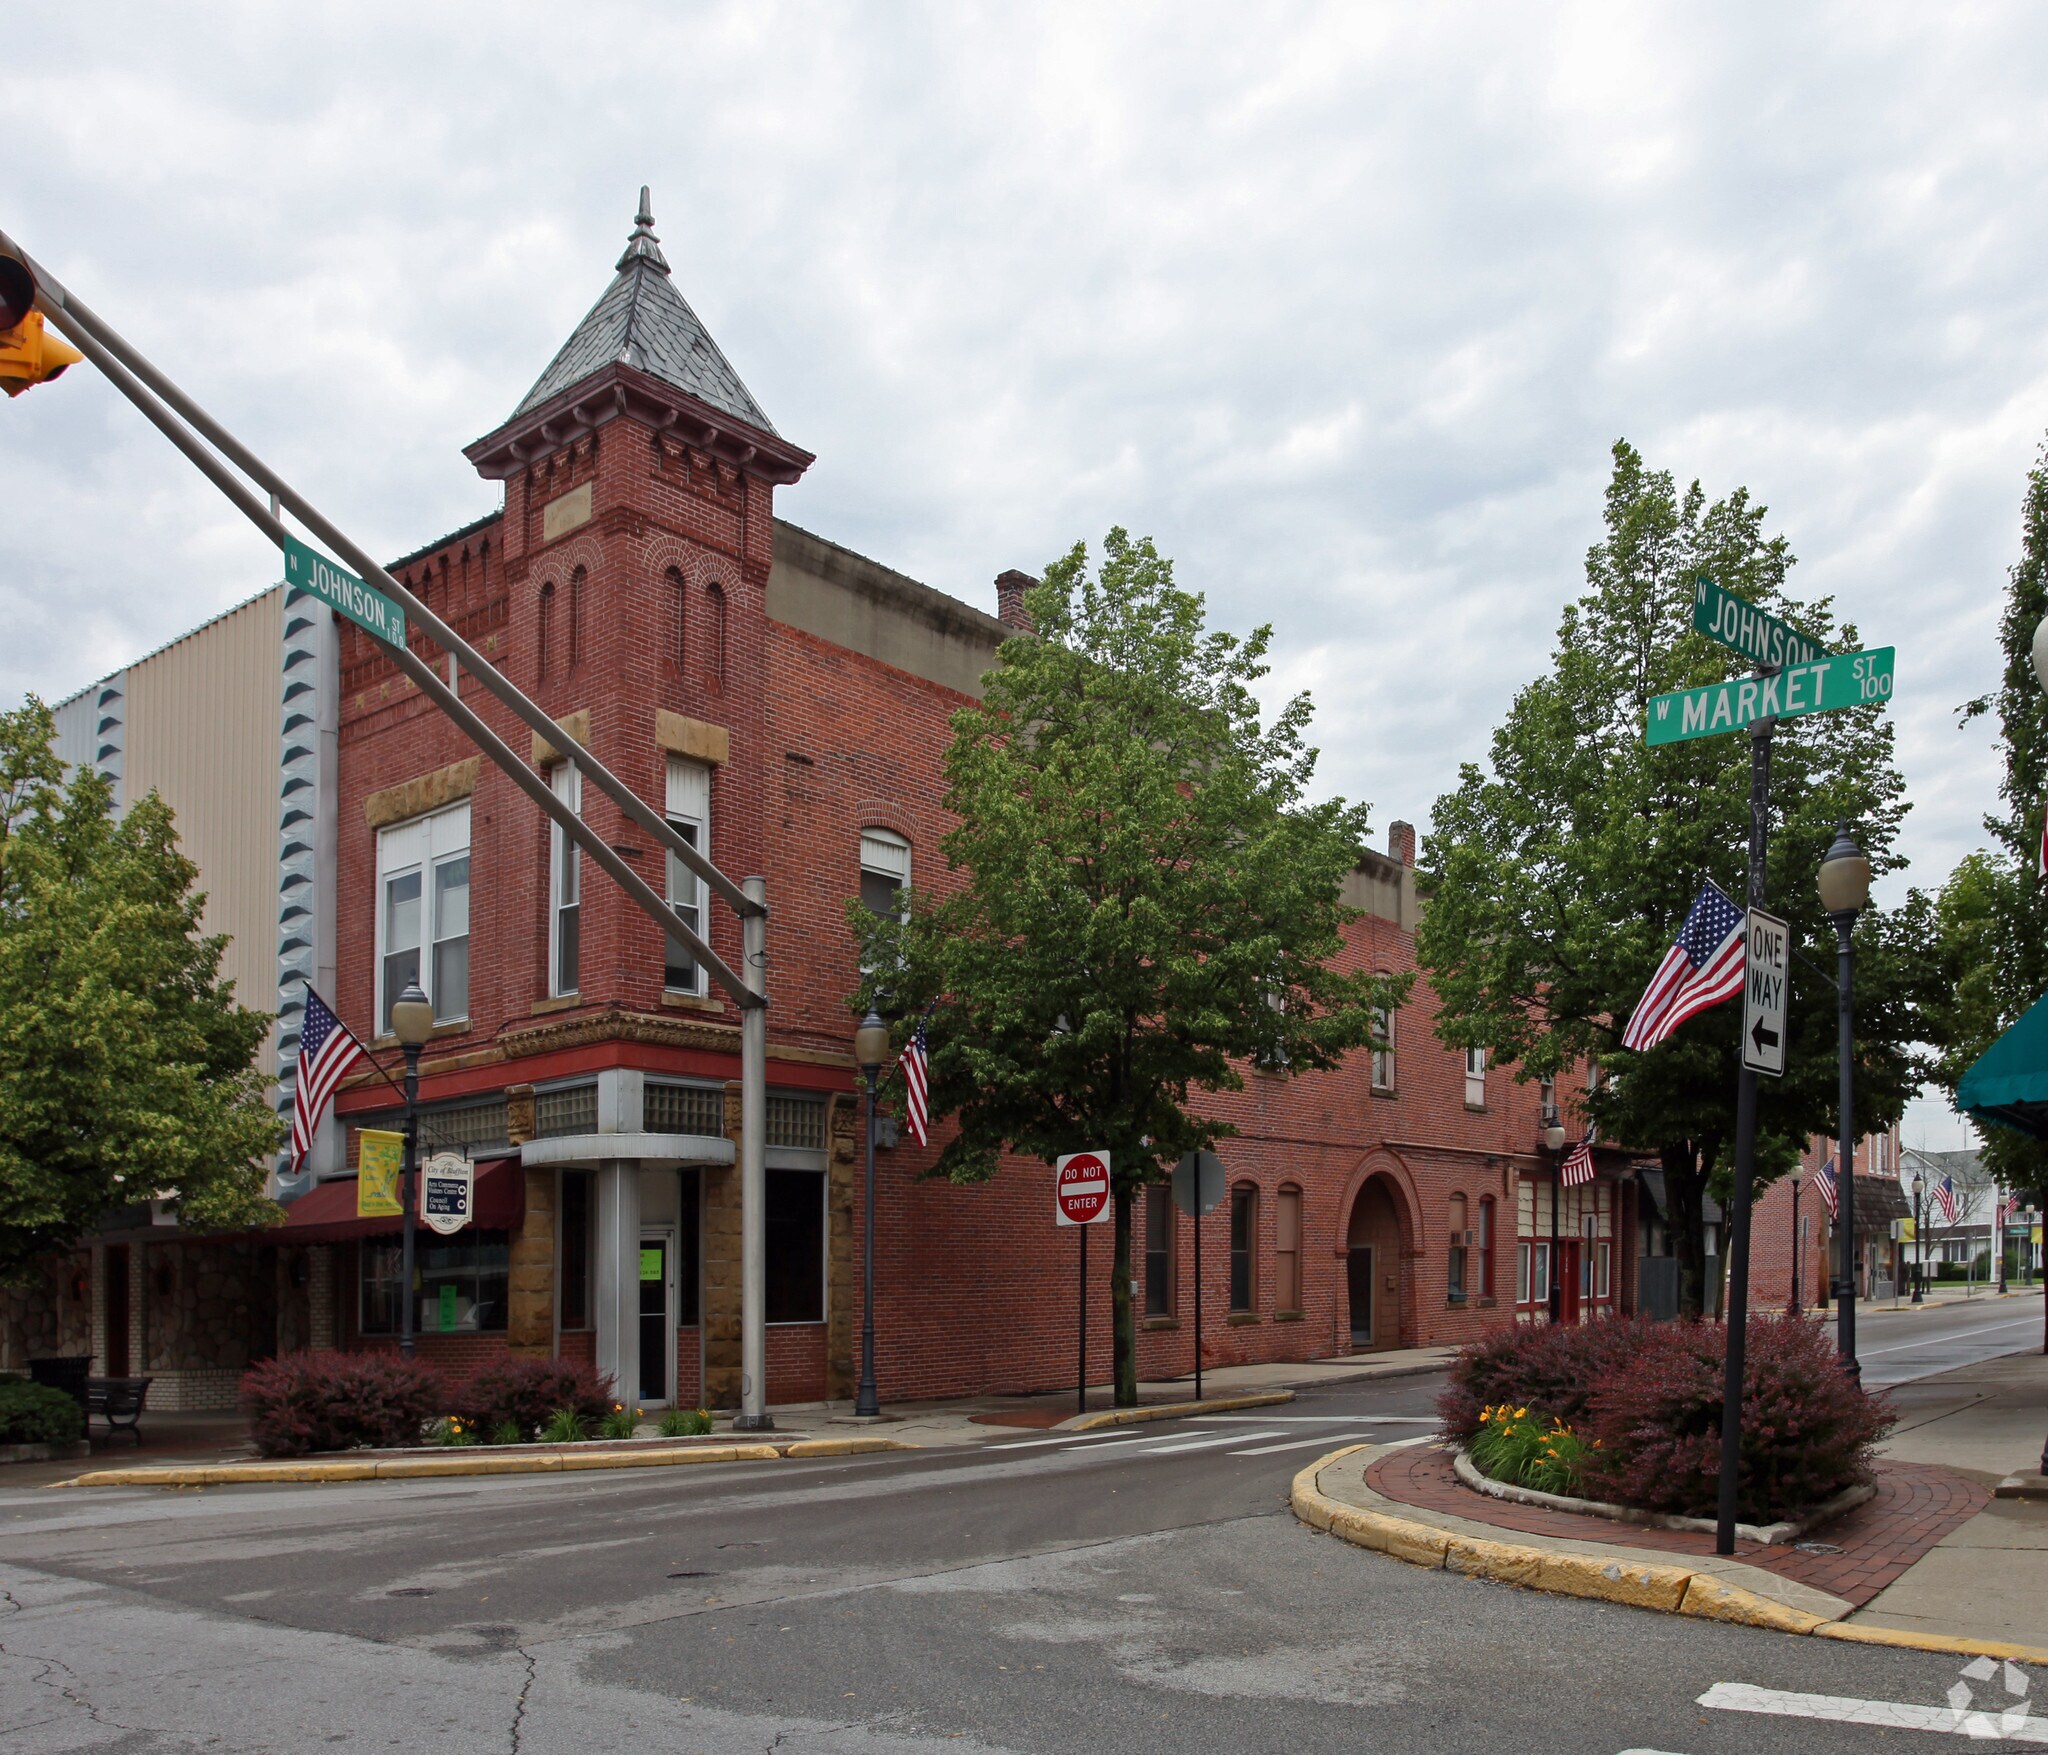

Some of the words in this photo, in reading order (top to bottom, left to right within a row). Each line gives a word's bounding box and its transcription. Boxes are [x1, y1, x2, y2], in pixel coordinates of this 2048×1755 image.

[290, 554, 297, 571] N
[308, 559, 385, 630] JOHNSON
[392, 617, 400, 634] ST
[1697, 581, 1707, 605] N
[387, 628, 404, 648] 100
[1656, 699, 1670, 721] W
[1681, 663, 1831, 734] MARKET
[1851, 655, 1877, 680] ST
[1860, 673, 1892, 700] 100
[1753, 926, 1782, 968] ONE
[1752, 968, 1782, 1011] WAY
[427, 1166, 439, 1175] City
[439, 1167, 447, 1175] of
[447, 1167, 469, 1176] Bluffton
[1065, 1168, 1077, 1180] DO
[1083, 1166, 1101, 1178] NOT
[429, 1196, 448, 1204] Council
[437, 1203, 451, 1212] Aging
[1068, 1197, 1097, 1210] ENTER
